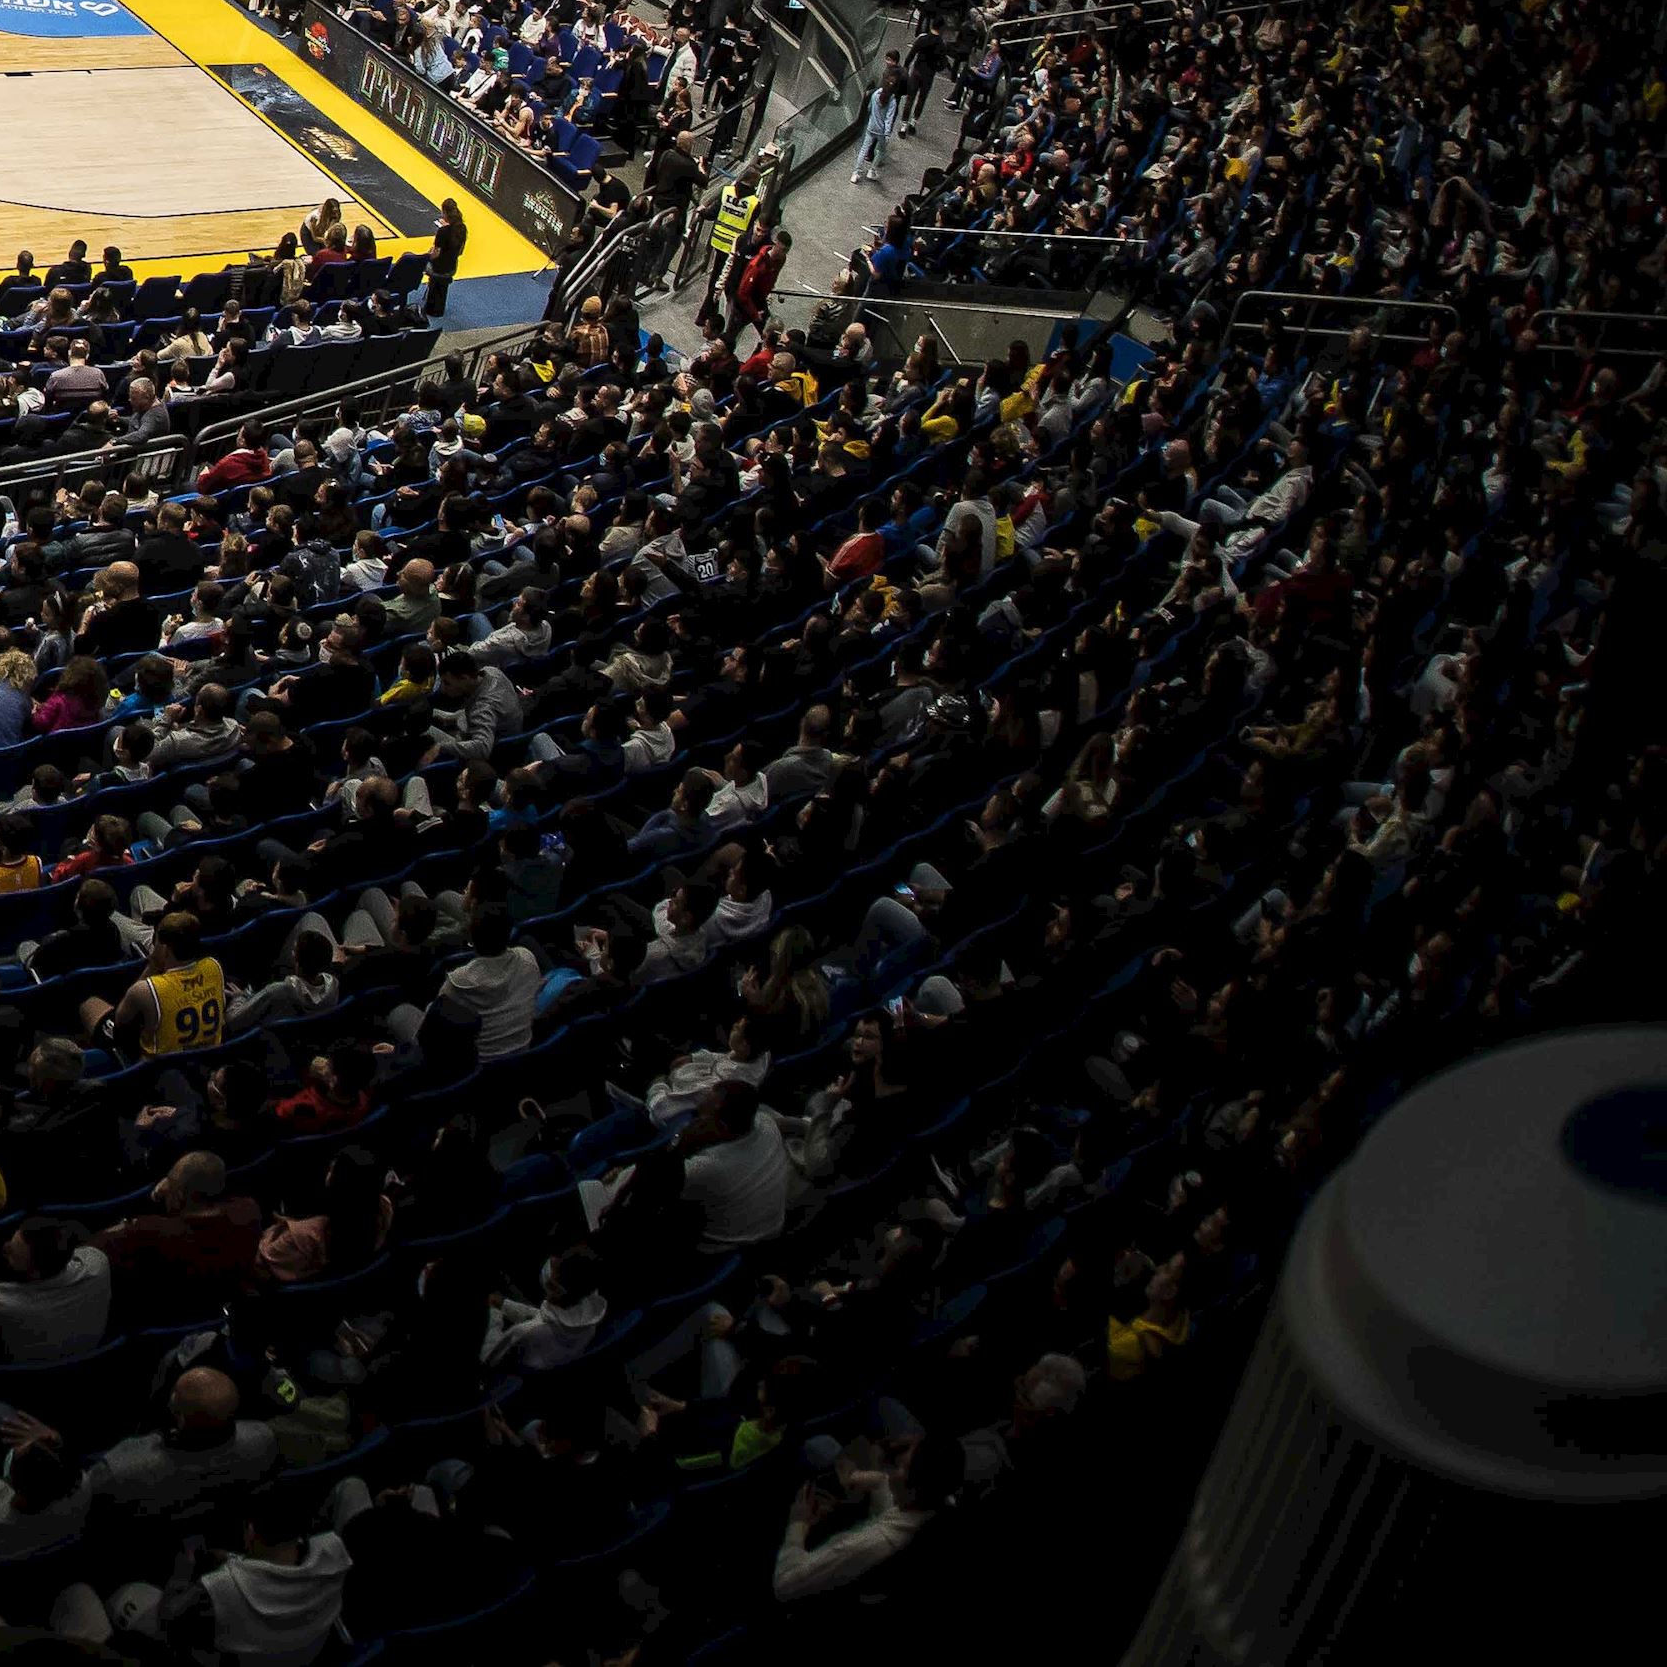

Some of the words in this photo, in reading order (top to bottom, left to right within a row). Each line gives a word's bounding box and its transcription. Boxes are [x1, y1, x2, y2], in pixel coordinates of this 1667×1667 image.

[360, 54, 428, 137] הבאים
[428, 105, 505, 198] ברוכים
[698, 563, 715, 579] 20
[177, 998, 219, 1043] 99
